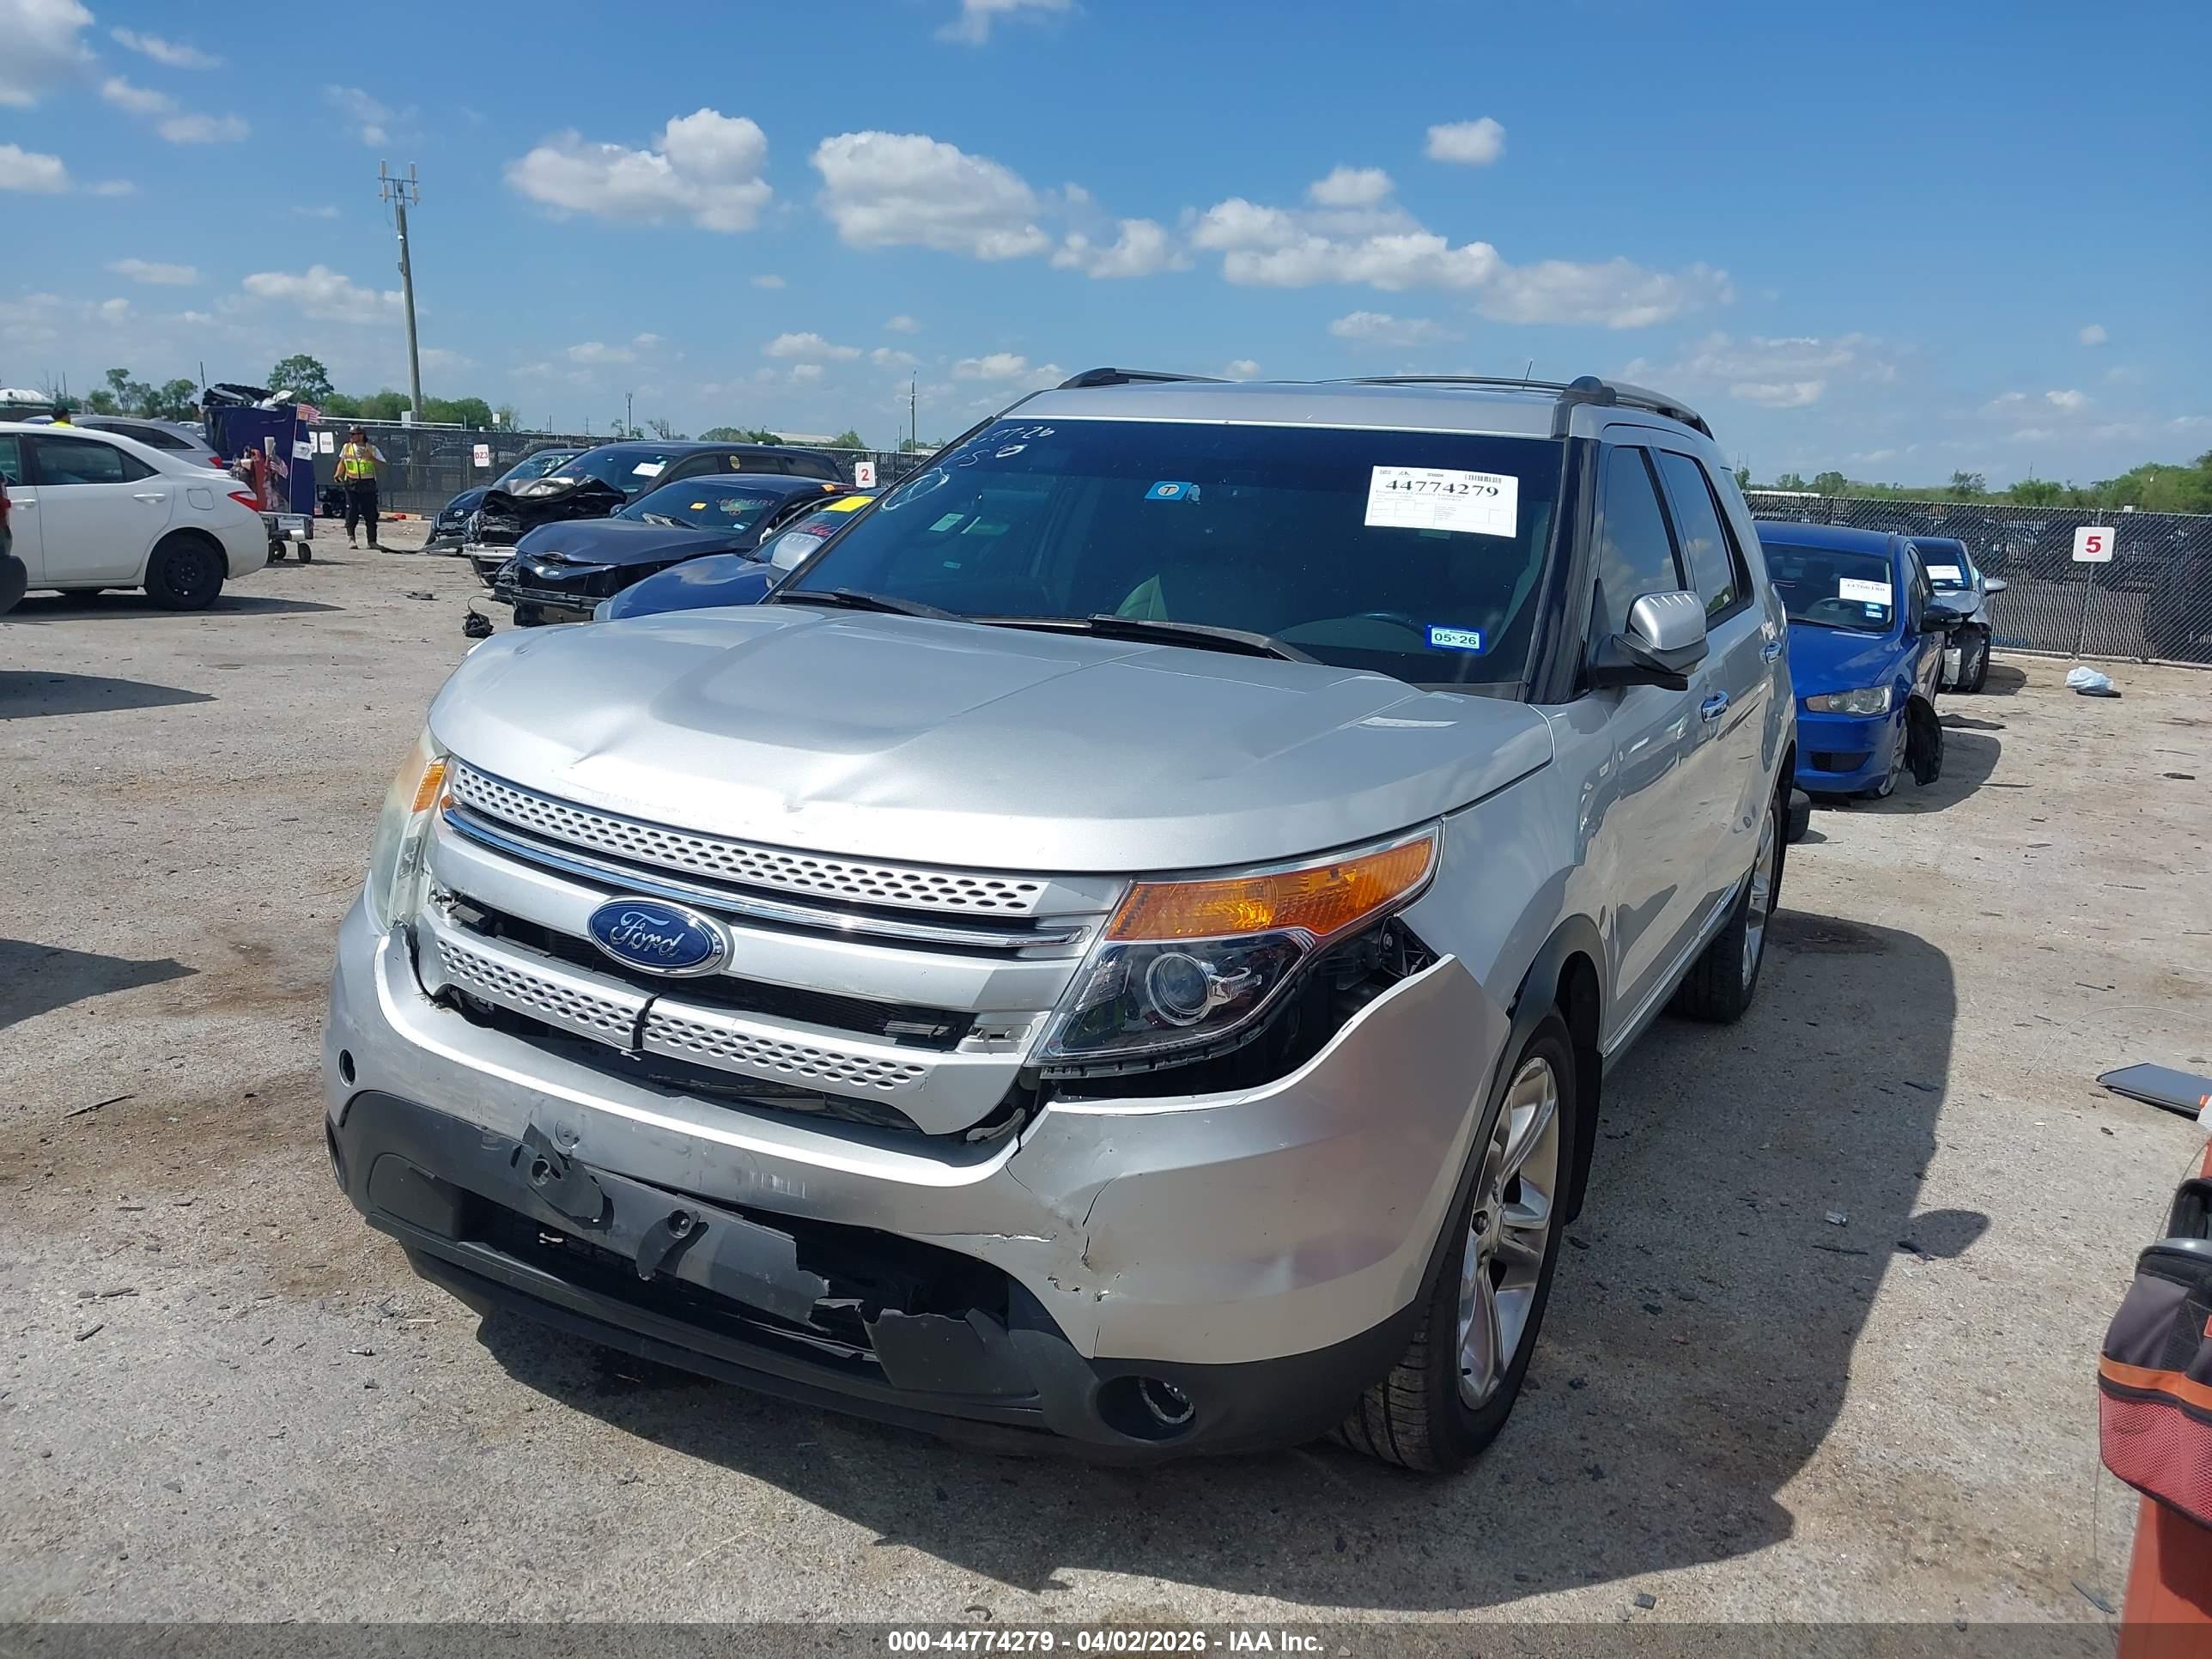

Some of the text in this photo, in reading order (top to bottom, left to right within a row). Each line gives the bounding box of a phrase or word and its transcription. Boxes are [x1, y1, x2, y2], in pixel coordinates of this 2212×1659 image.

[860, 468, 870, 481] 2
[1385, 480, 1499, 497] 44774279
[2085, 535, 2102, 553] 5
[610, 911, 685, 957] Ford
